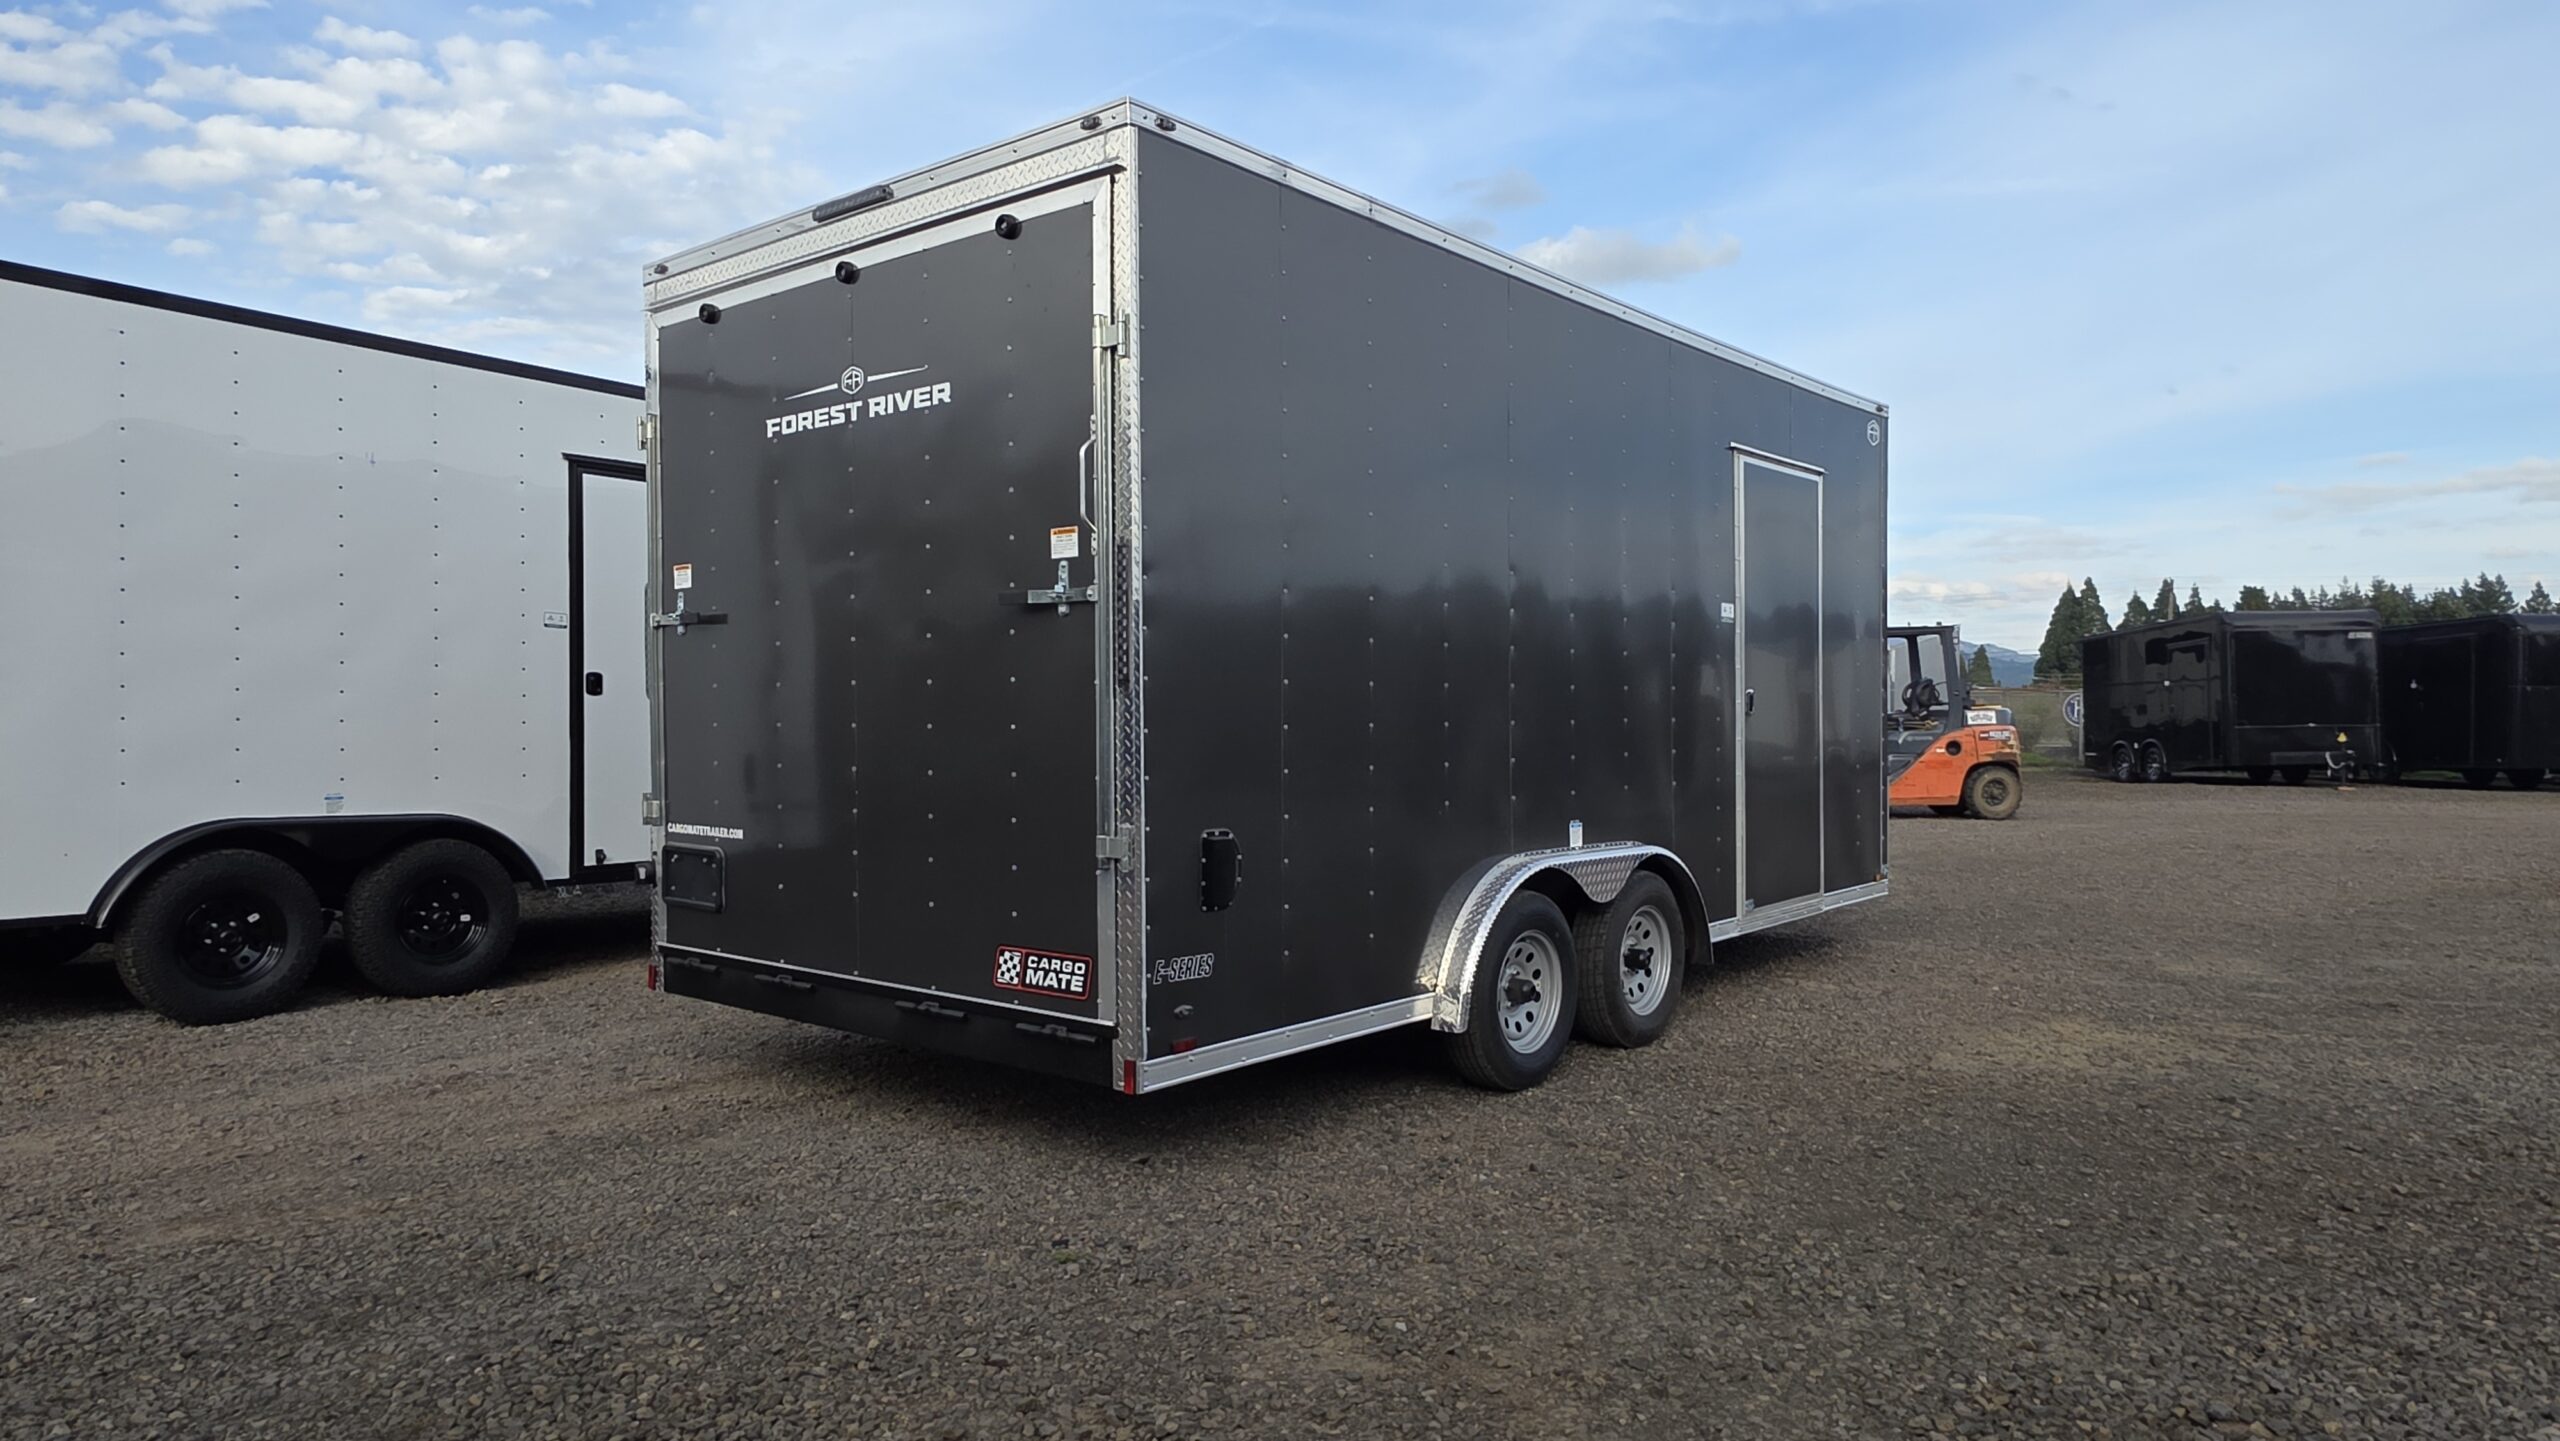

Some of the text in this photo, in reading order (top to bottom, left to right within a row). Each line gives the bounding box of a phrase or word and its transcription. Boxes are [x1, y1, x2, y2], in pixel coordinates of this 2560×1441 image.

[766, 382, 952, 438] FOREST RIVER
[1027, 956, 1086, 975] CARGO
[1152, 953, 1214, 985] E-SERIES
[1025, 969, 1085, 992] MATE
